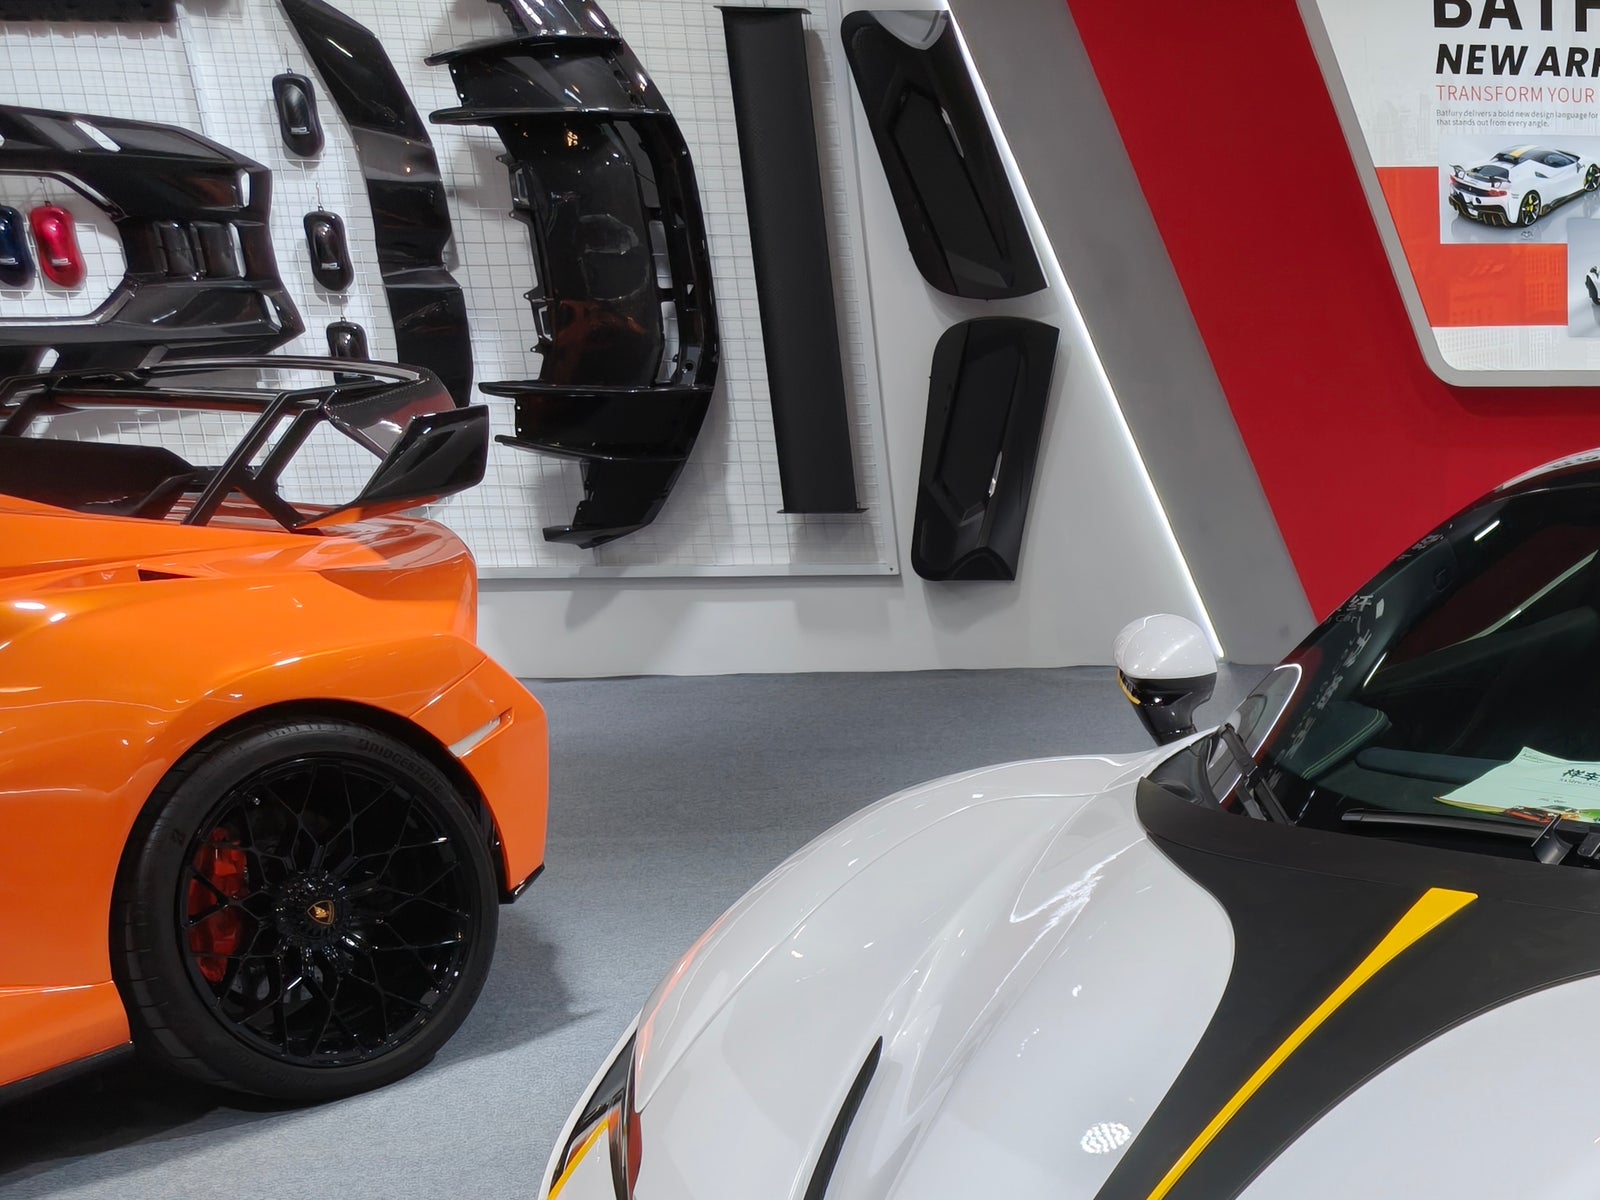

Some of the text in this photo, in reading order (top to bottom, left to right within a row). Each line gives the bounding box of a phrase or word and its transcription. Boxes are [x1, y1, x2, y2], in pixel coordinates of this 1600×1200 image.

[1436, 44, 1529, 76] NEW
[1436, 85, 1543, 103] TRANSFORM
[1548, 87, 1594, 104] YOUR
[1464, 110, 1491, 118] delivers
[1499, 110, 1514, 118] bold
[1531, 111, 1554, 120] design
[1555, 111, 1587, 121] language
[1527, 120, 1549, 129] angle.
